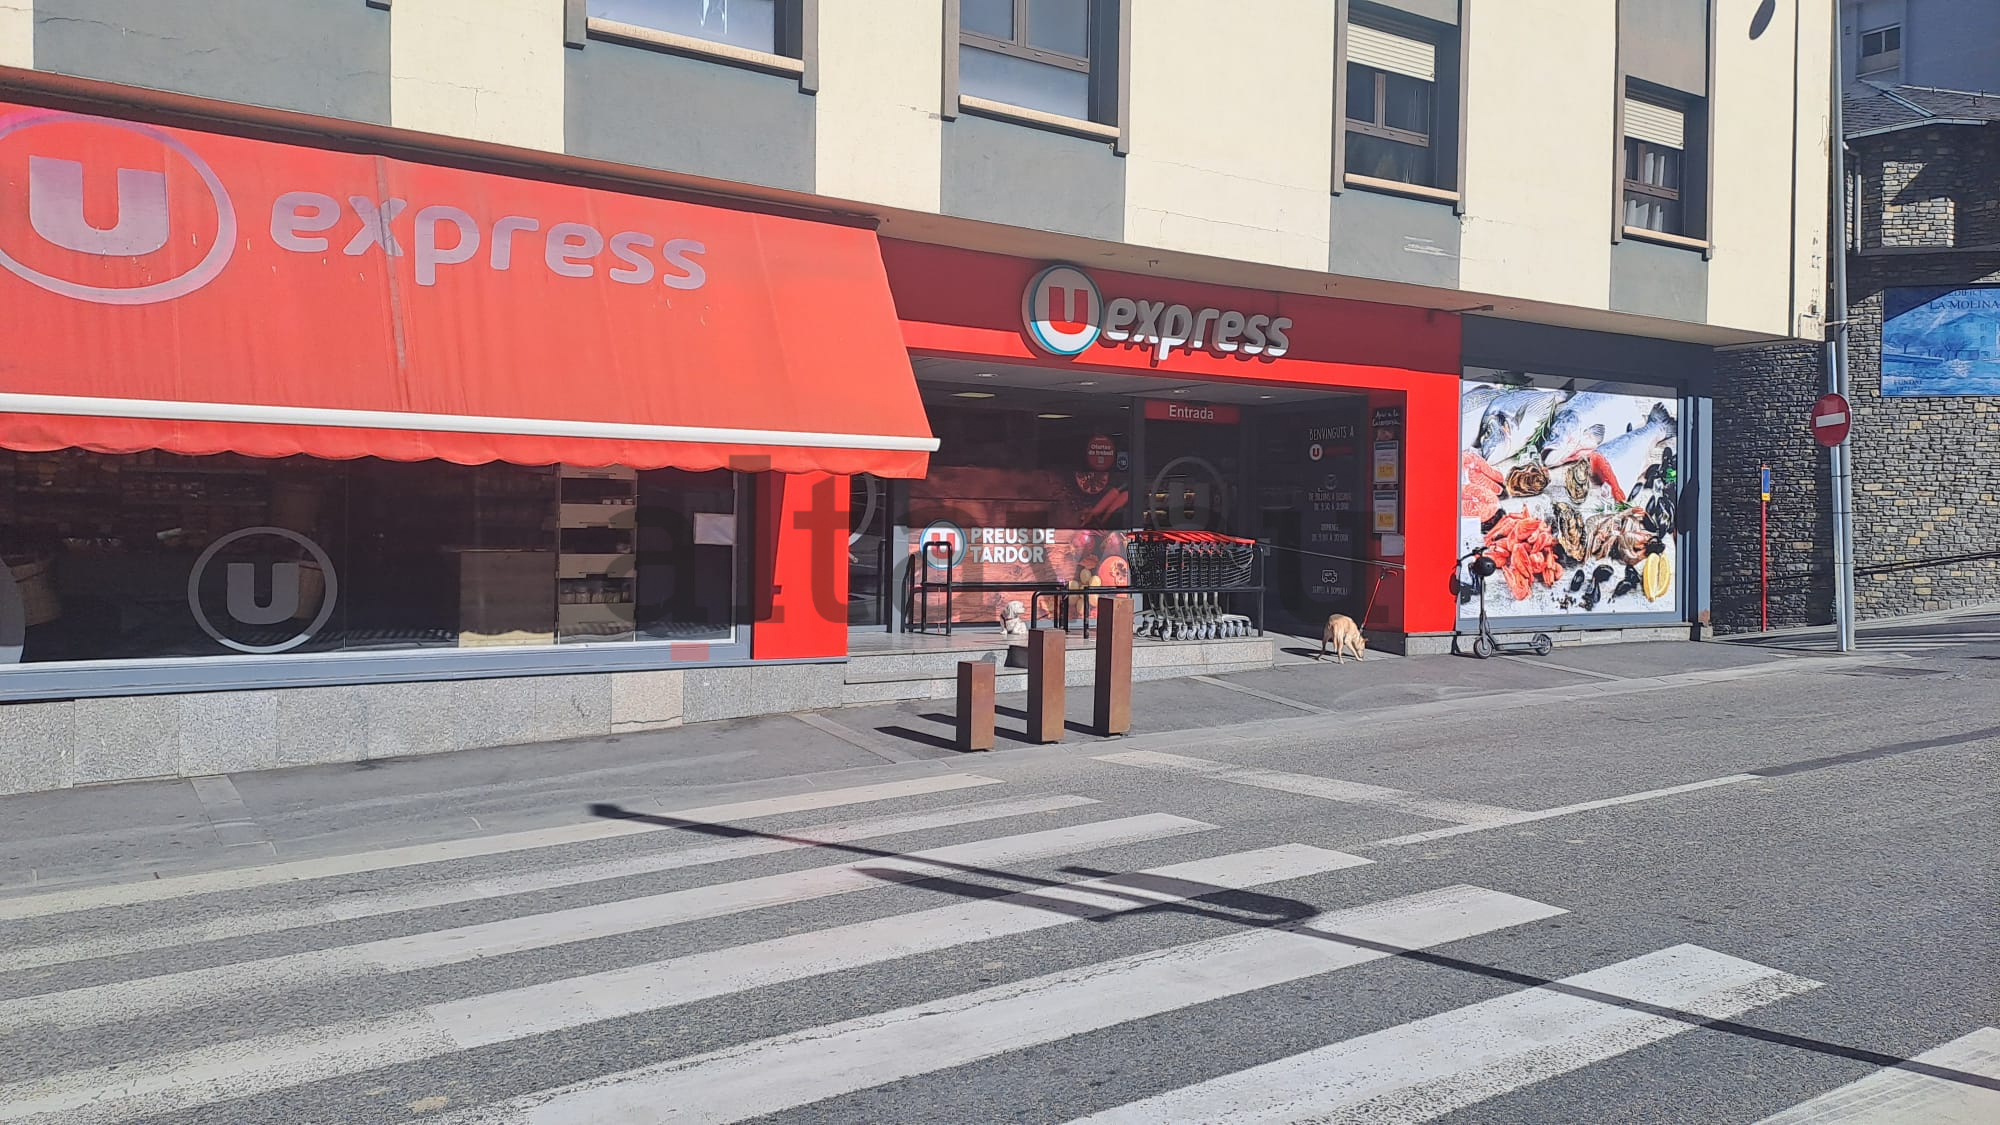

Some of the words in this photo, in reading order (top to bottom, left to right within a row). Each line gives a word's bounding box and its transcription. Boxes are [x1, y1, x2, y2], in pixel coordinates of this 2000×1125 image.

[269, 190, 707, 290] express
[1930, 301, 1946, 310] LA
[1949, 300, 2000, 310] MOLINA
[1104, 297, 1293, 361] express
[1169, 404, 1214, 420] Entrada
[1309, 425, 1347, 441] BENVINGUTS
[970, 527, 1028, 545] PREUS
[1032, 527, 1056, 545] DE
[969, 546, 1045, 563] TARDOR
[226, 563, 299, 624] U
